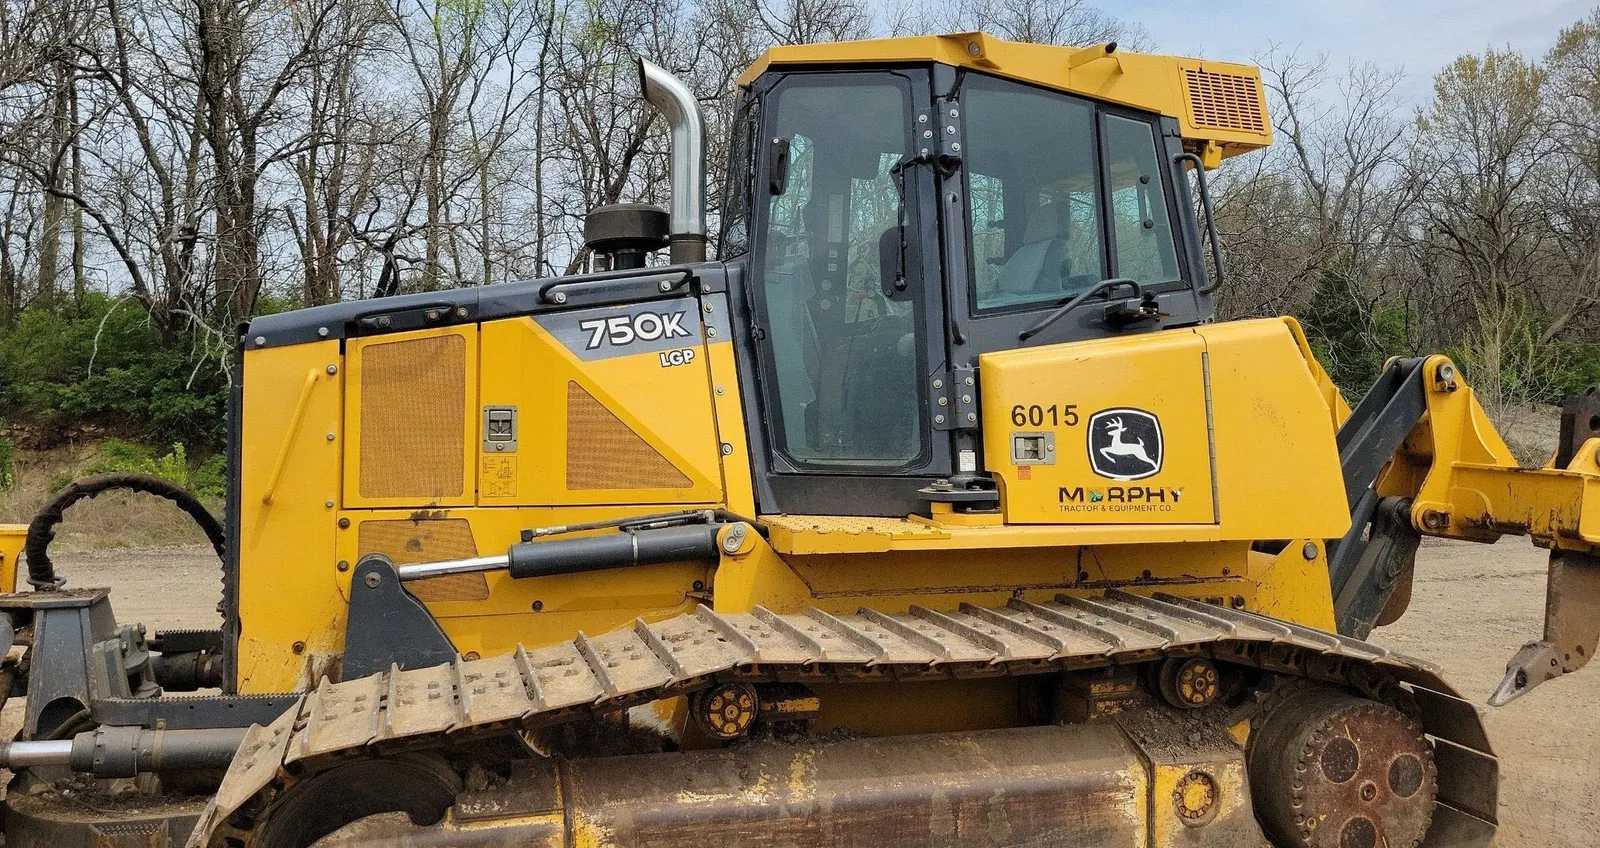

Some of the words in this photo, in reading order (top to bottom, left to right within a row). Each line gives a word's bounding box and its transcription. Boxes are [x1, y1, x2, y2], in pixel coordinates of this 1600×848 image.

[579, 311, 694, 350] 750K
[659, 349, 695, 367] LGP
[1011, 405, 1079, 426] 6015
